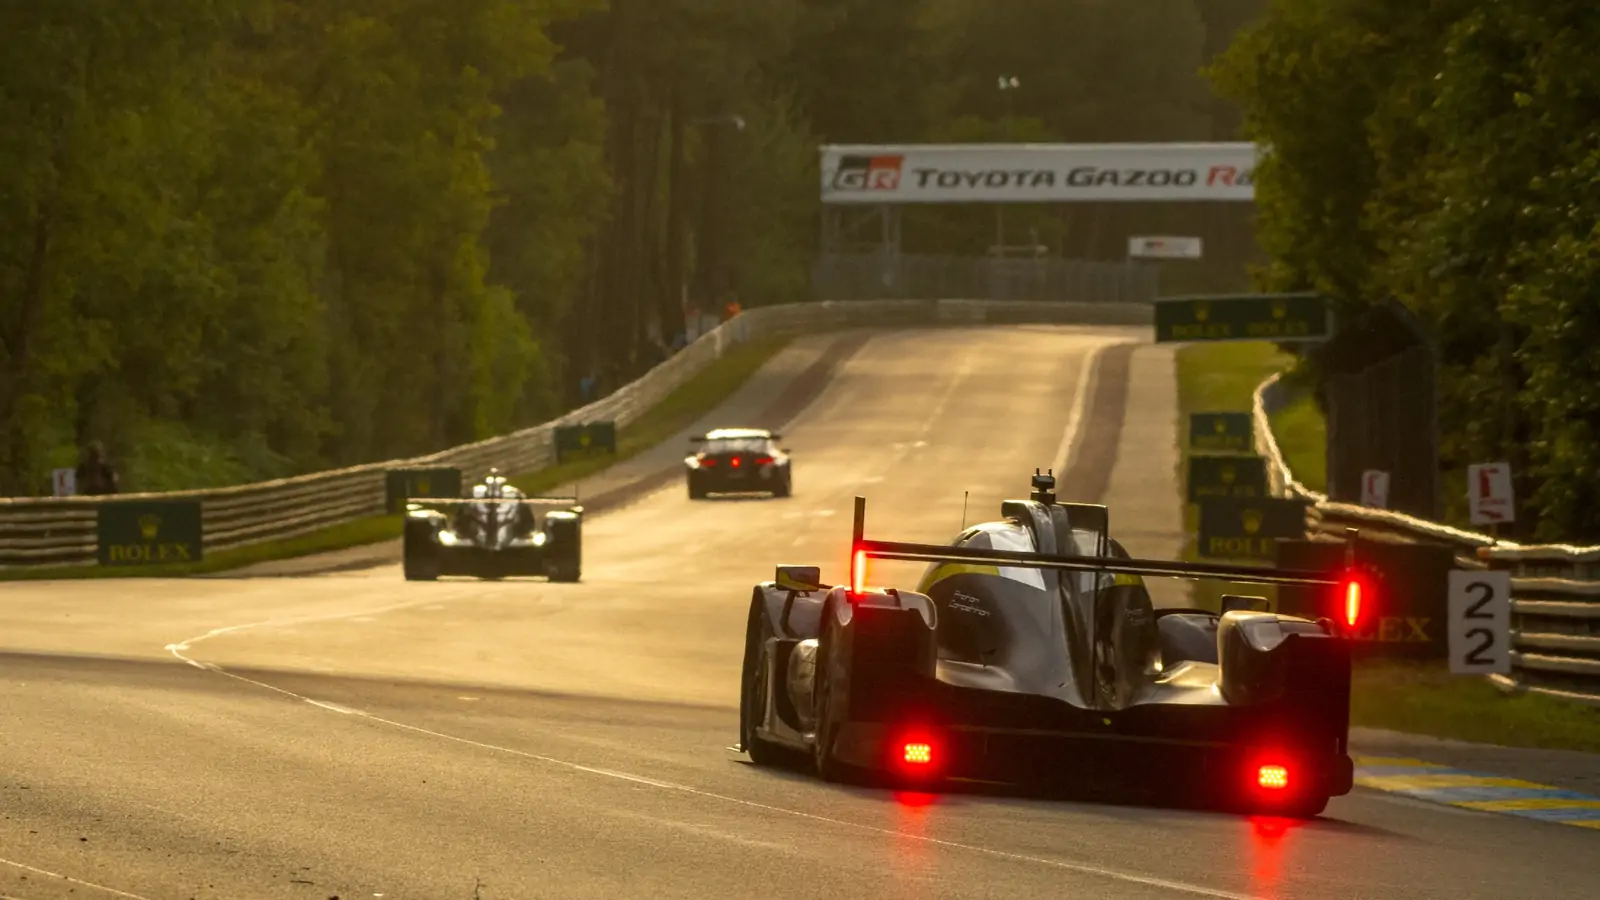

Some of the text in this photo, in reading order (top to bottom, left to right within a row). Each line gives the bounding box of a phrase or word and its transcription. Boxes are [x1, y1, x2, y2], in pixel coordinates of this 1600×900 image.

[911, 167, 1055, 188] TOYOTA
[1066, 165, 1197, 188] GAZOO
[109, 542, 192, 561] ROLEX
